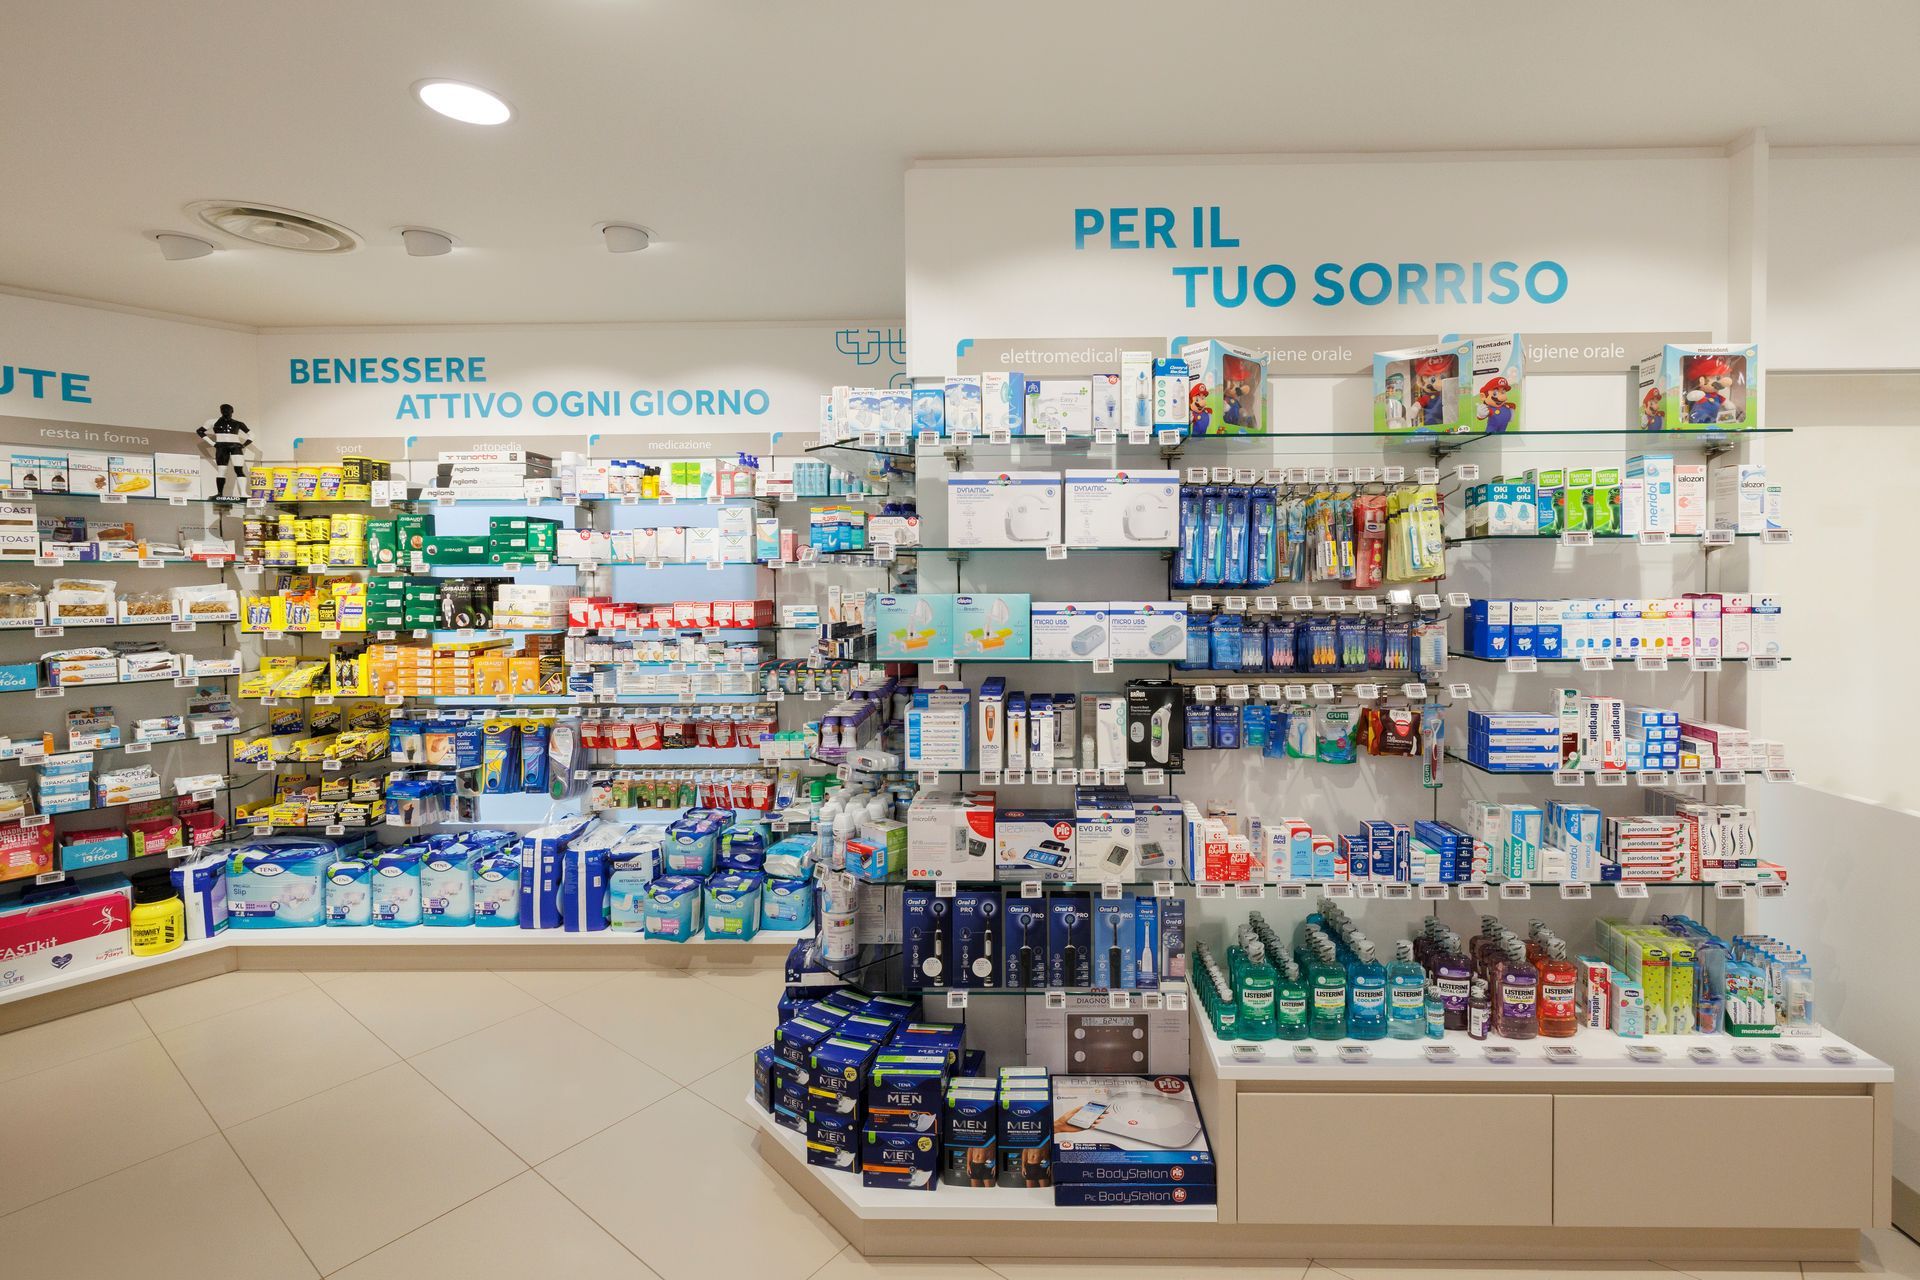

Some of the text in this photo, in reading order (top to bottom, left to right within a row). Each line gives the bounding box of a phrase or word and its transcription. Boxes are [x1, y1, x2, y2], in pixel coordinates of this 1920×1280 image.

[1074, 206, 1240, 250] PER IL
[1172, 261, 1569, 308] TUO SORRISO
[1476, 340, 1511, 350] mentadent
[1000, 347, 1123, 364] elettromedicali
[1257, 346, 1353, 365] giene orale
[1528, 343, 1625, 363] igiene orale
[290, 357, 487, 384] BENESSERE
[396, 388, 770, 420] ATTIVO OGNI GIORNO
[40, 427, 149, 446] resta in forma
[335, 443, 363, 454] sport
[472, 440, 522, 452] ortopedia
[648, 439, 712, 450] medicazione
[1678, 475, 1705, 483] ialozon
[1741, 481, 1765, 489] ialozon
[1493, 493, 1508, 501] gola
[1516, 493, 1531, 501] gola
[1650, 482, 1659, 526] meridol
[131, 670, 171, 679] LOWCARB
[1327, 712, 1349, 720] GUM
[1590, 703, 1599, 742] Biorepair
[1610, 702, 1621, 742] Biorepair
[1513, 842, 1522, 877] elmex
[1570, 844, 1578, 879] meridol
[234, 888, 247, 897] Slip
[1439, 982, 1468, 990] LISTERINE
[1544, 987, 1574, 995] LISTERINE
[1244, 990, 1273, 999] LISTERINE
[1316, 990, 1345, 998] LISTERINE
[1355, 990, 1384, 998] LISTERINE
[1393, 990, 1422, 998] LISTERINE
[1504, 988, 1534, 996] LISTERINE
[1590, 995, 1599, 1028] Biorepair
[783, 1048, 804, 1060] MEN
[819, 1076, 848, 1089] MEN
[1070, 1078, 1149, 1087] BodyStation
[783, 1096, 804, 1109] MEN
[887, 1095, 922, 1104] MEN
[952, 1120, 987, 1130] MEN
[1007, 1121, 1042, 1130] MEN
[817, 1131, 846, 1143] MEN
[883, 1151, 916, 1160] MEN
[1096, 1168, 1168, 1180] BodyStation
[1099, 1191, 1171, 1203] BodyStation
